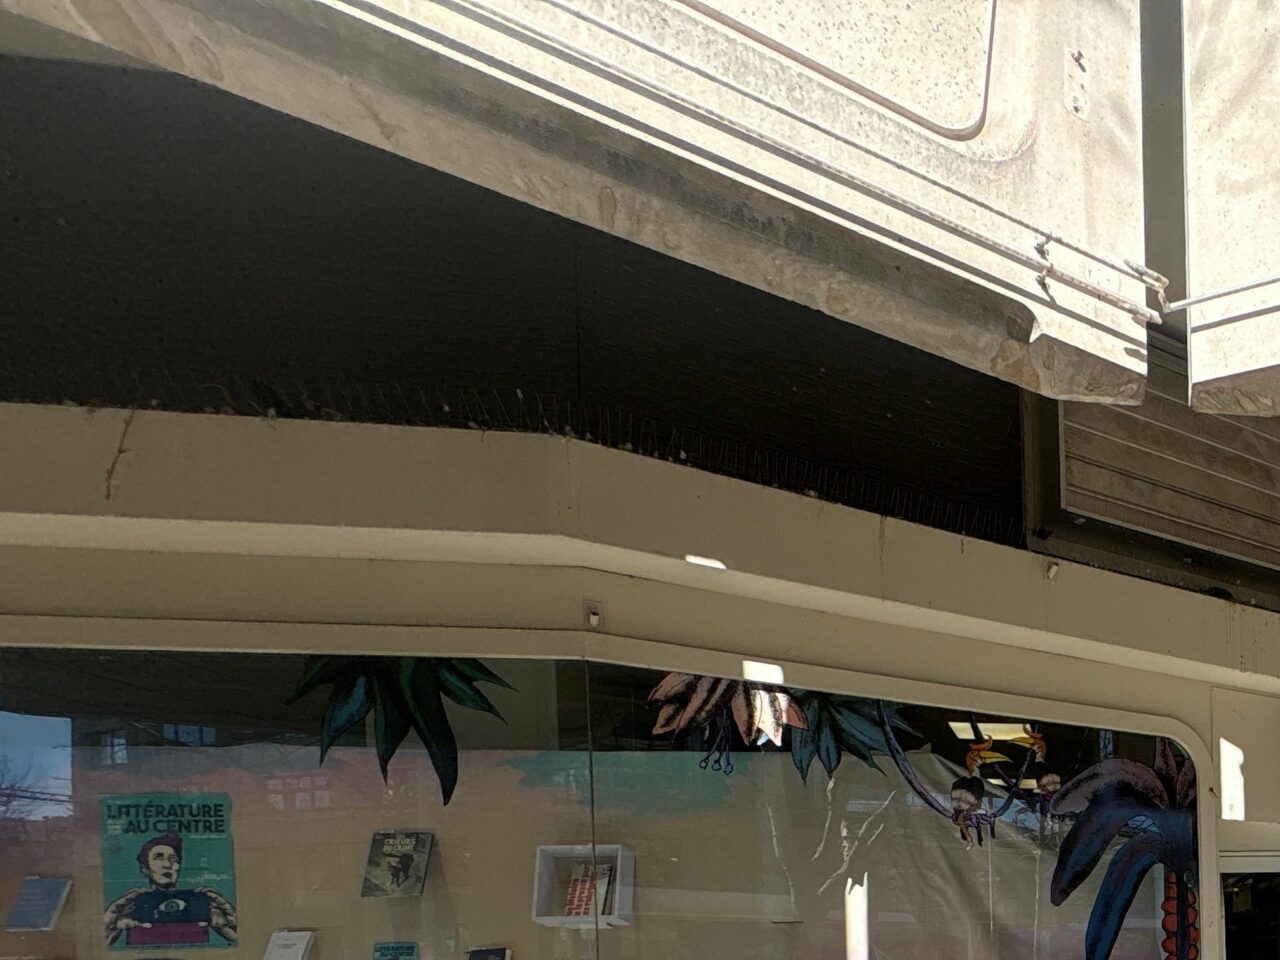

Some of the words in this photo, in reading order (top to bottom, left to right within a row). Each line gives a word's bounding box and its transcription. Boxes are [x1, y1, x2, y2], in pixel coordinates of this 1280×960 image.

[106, 801, 225, 819] LITTÉRATURE
[125, 819, 149, 834] AU
[153, 819, 225, 834] CENTRE
